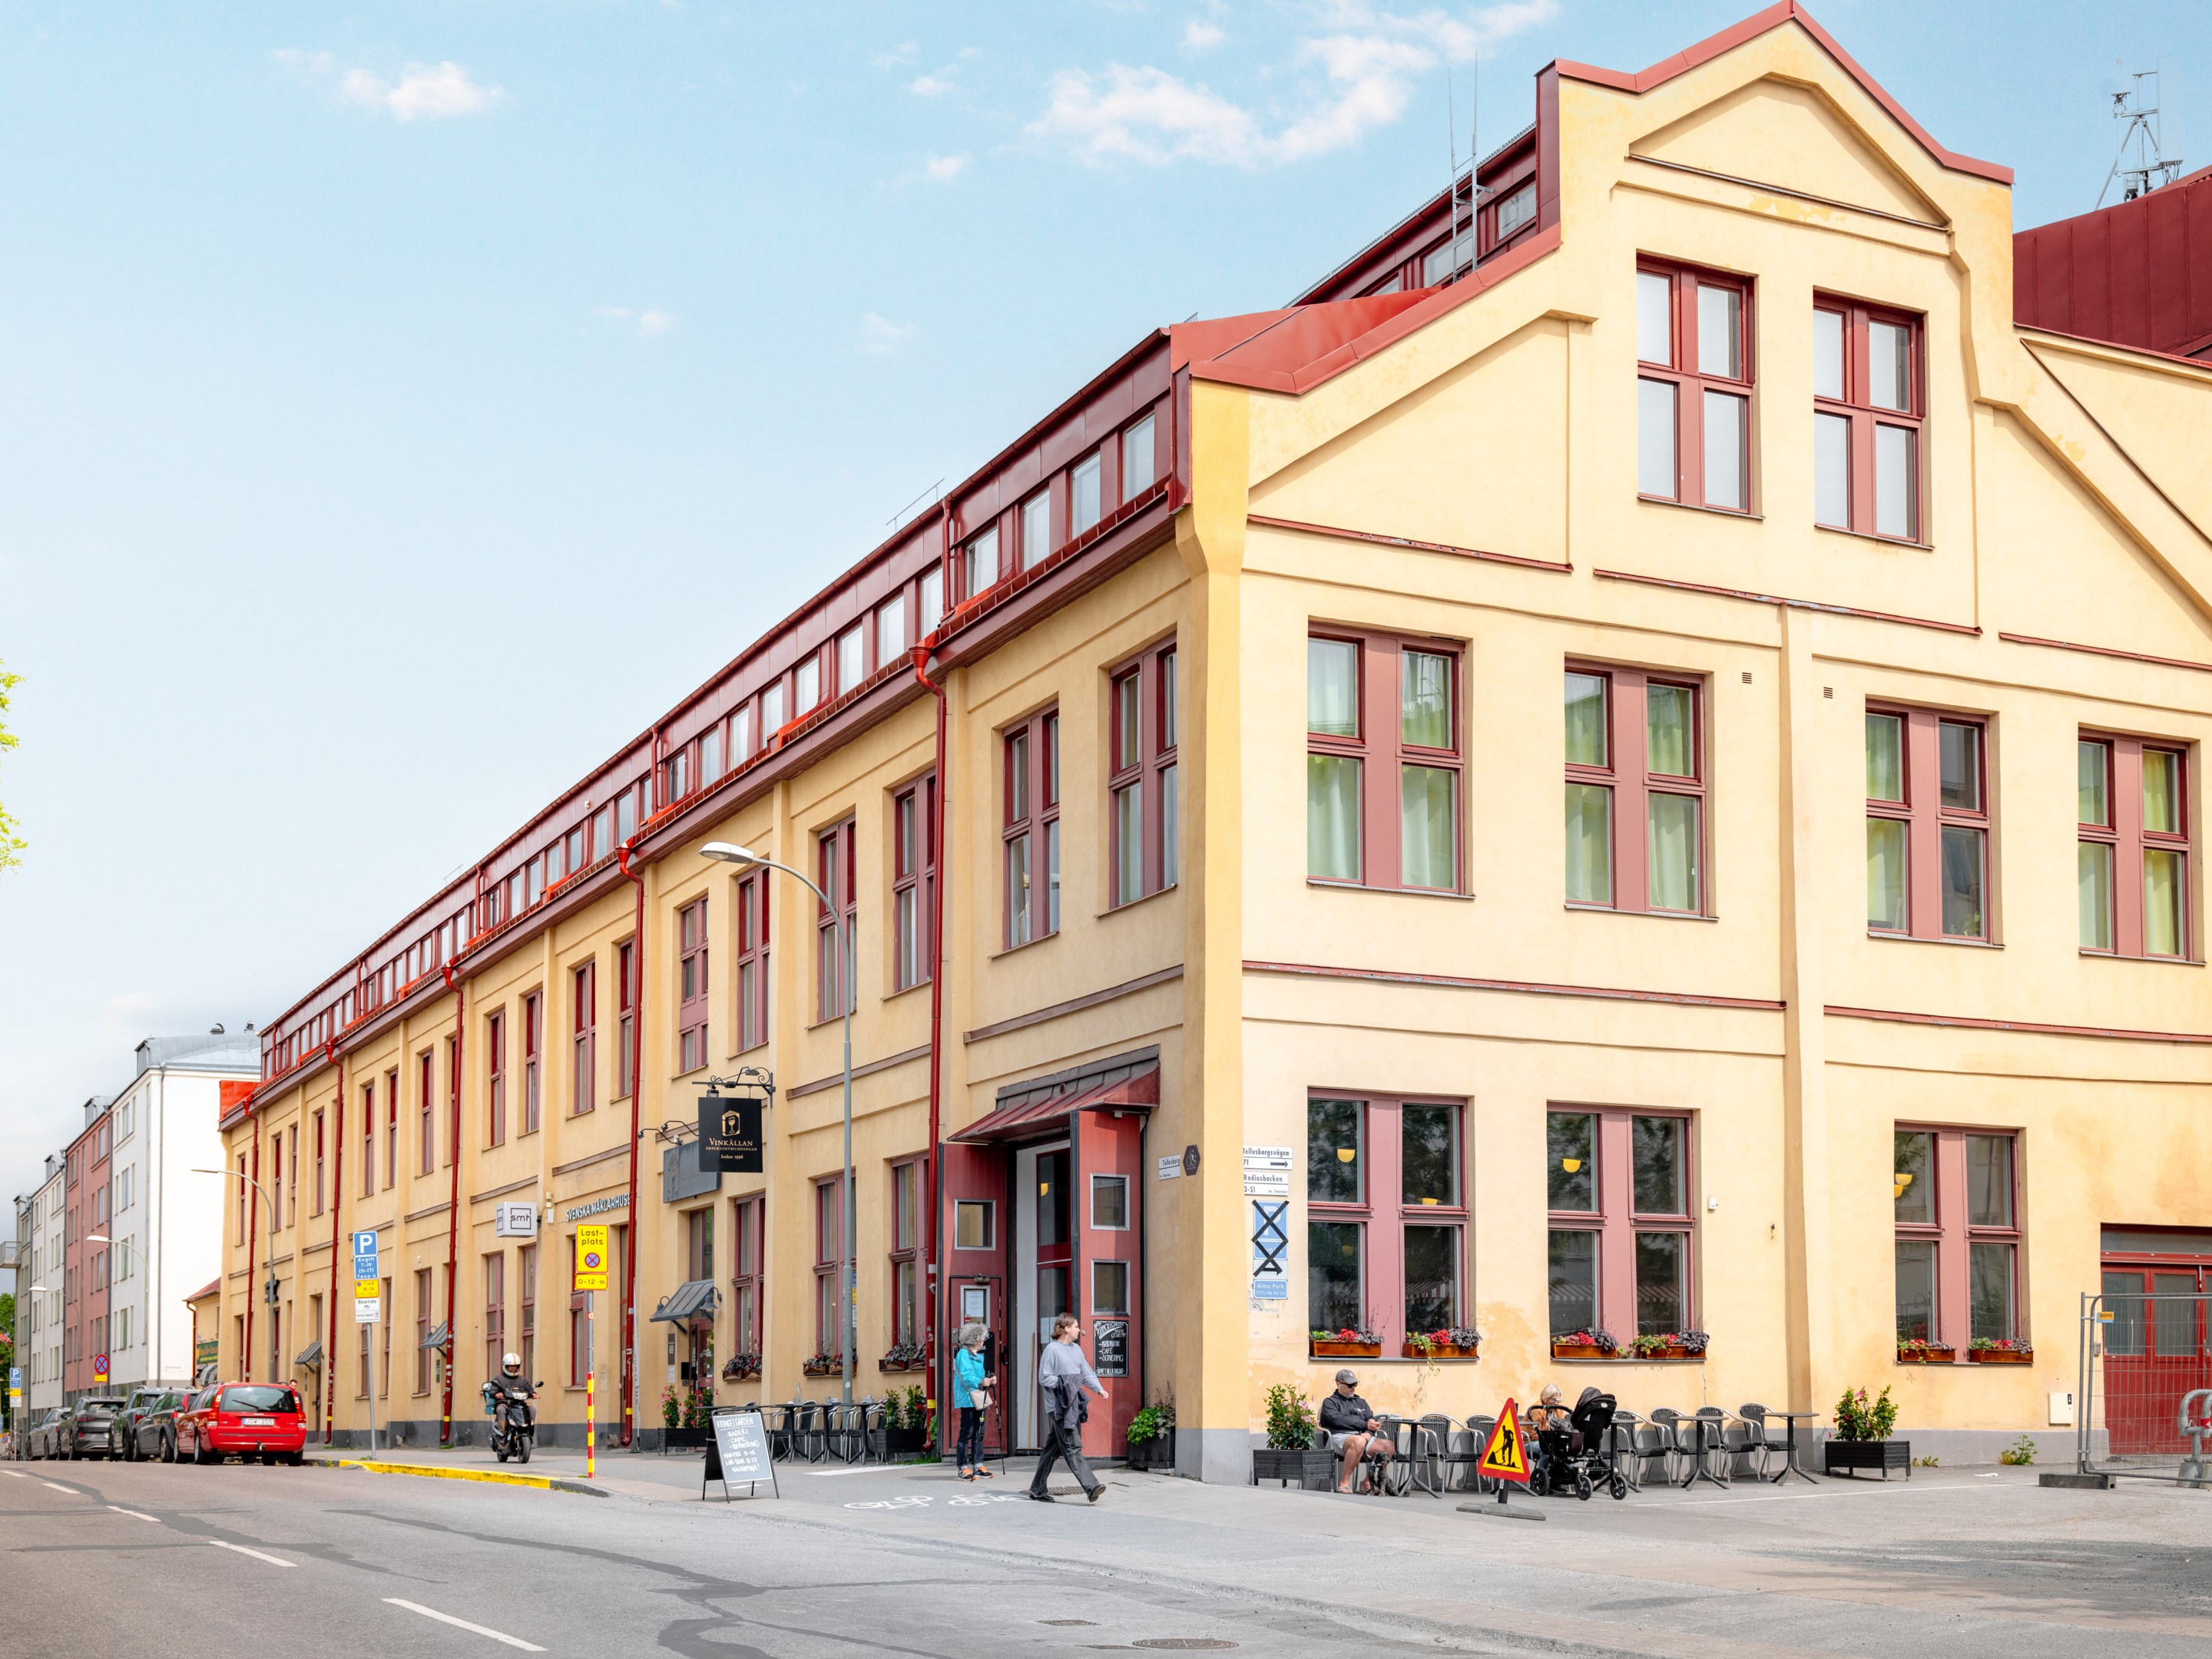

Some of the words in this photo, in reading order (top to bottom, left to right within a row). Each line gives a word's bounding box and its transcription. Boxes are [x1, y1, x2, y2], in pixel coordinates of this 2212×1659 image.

[709, 1137, 753, 1146] VINKÄLLAN
[1243, 1147, 1290, 1157] Tellusborgsvägen
[1162, 1157, 1181, 1167] Tellusborg
[565, 1204, 591, 1221] SVENSKA
[591, 1192, 631, 1216] MÄKLARHUSE
[510, 1214, 531, 1222] smh
[359, 1234, 373, 1253] P
[12, 1369, 19, 1378] P
